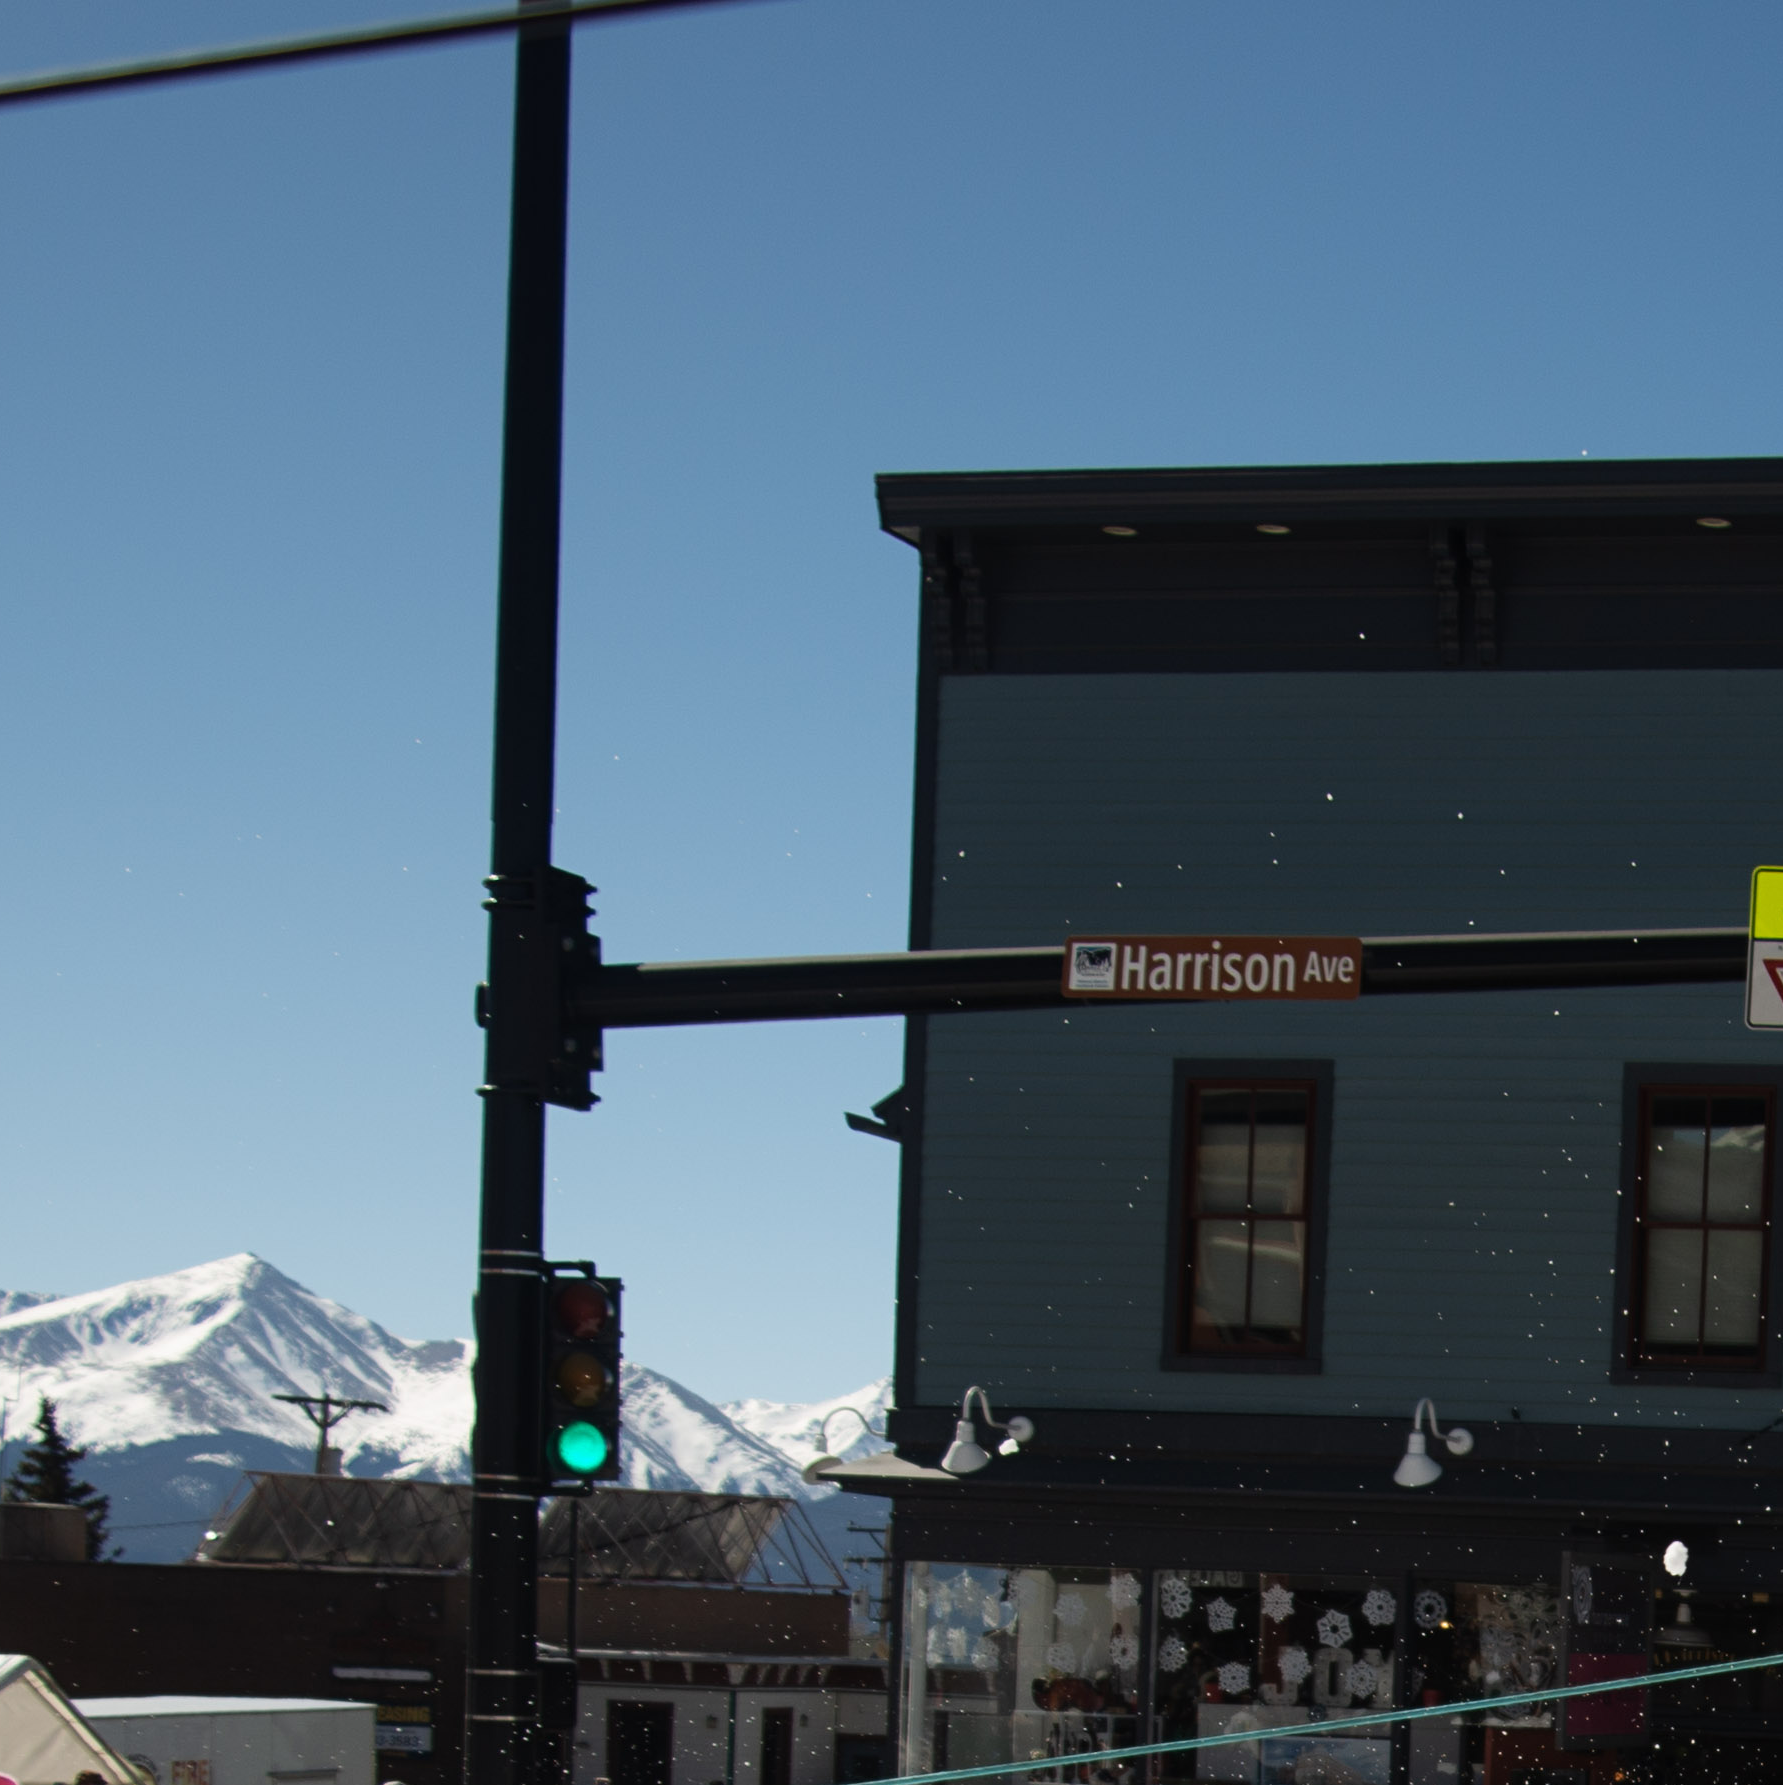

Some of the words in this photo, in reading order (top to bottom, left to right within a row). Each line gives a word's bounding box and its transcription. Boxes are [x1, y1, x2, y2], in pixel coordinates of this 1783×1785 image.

[1120, 939, 1297, 993] Harrison
[1302, 951, 1356, 985] Ave
[377, 1705, 431, 1723] EASING
